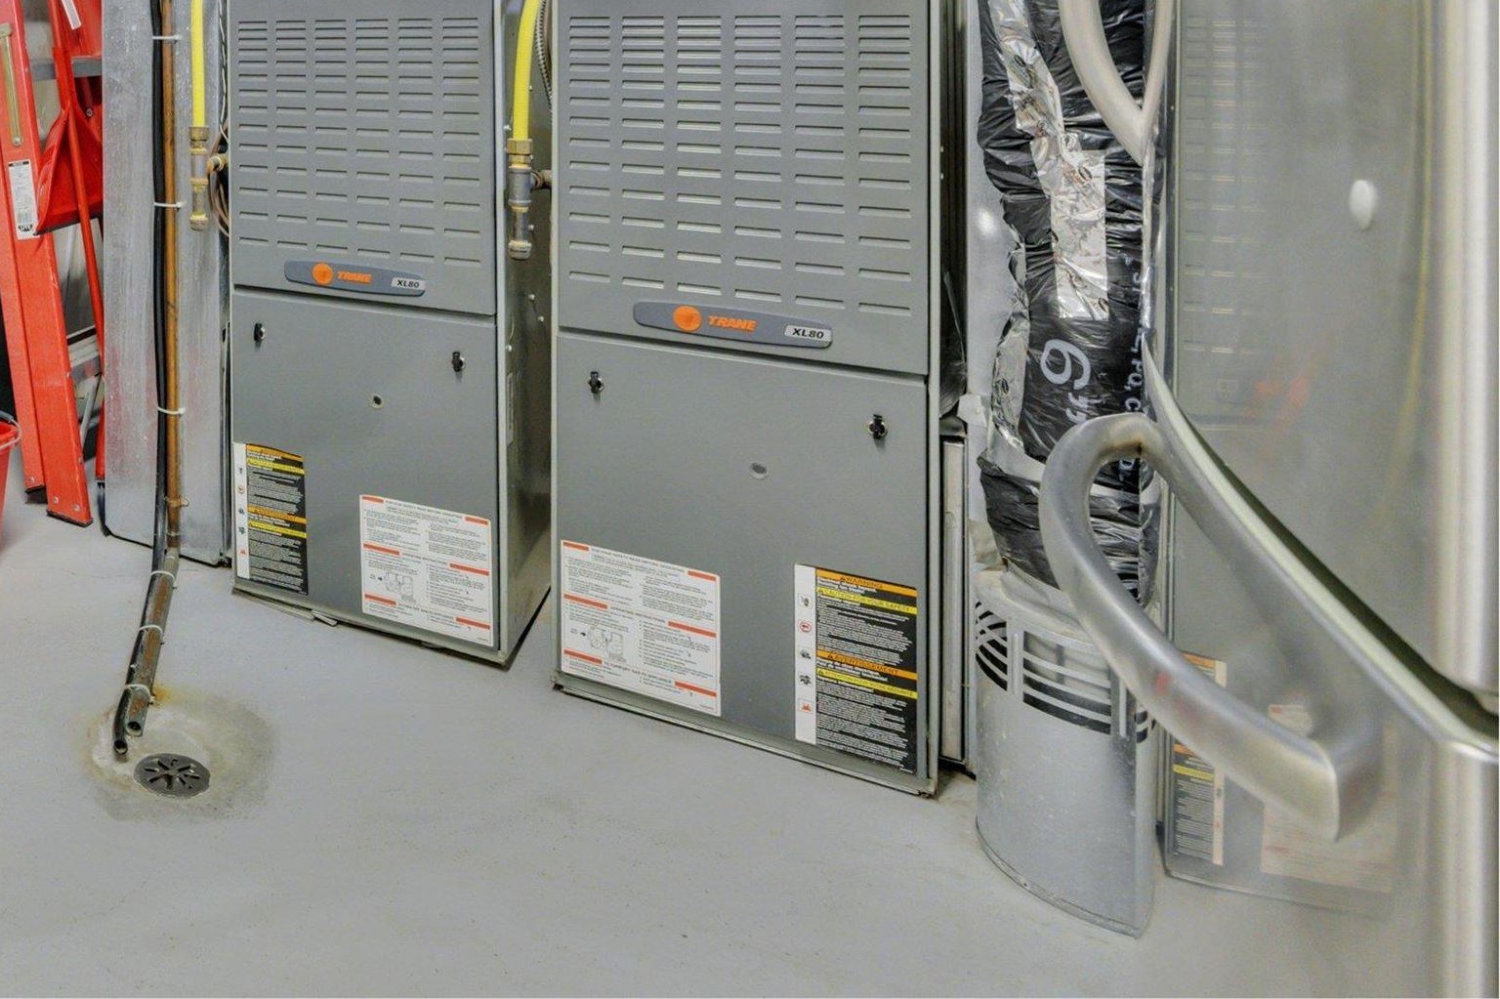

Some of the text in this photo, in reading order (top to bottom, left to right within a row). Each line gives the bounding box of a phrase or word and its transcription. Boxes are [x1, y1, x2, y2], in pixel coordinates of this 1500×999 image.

[337, 270, 420, 289] TRANE XL80
[707, 315, 825, 340] TRANE XL80
